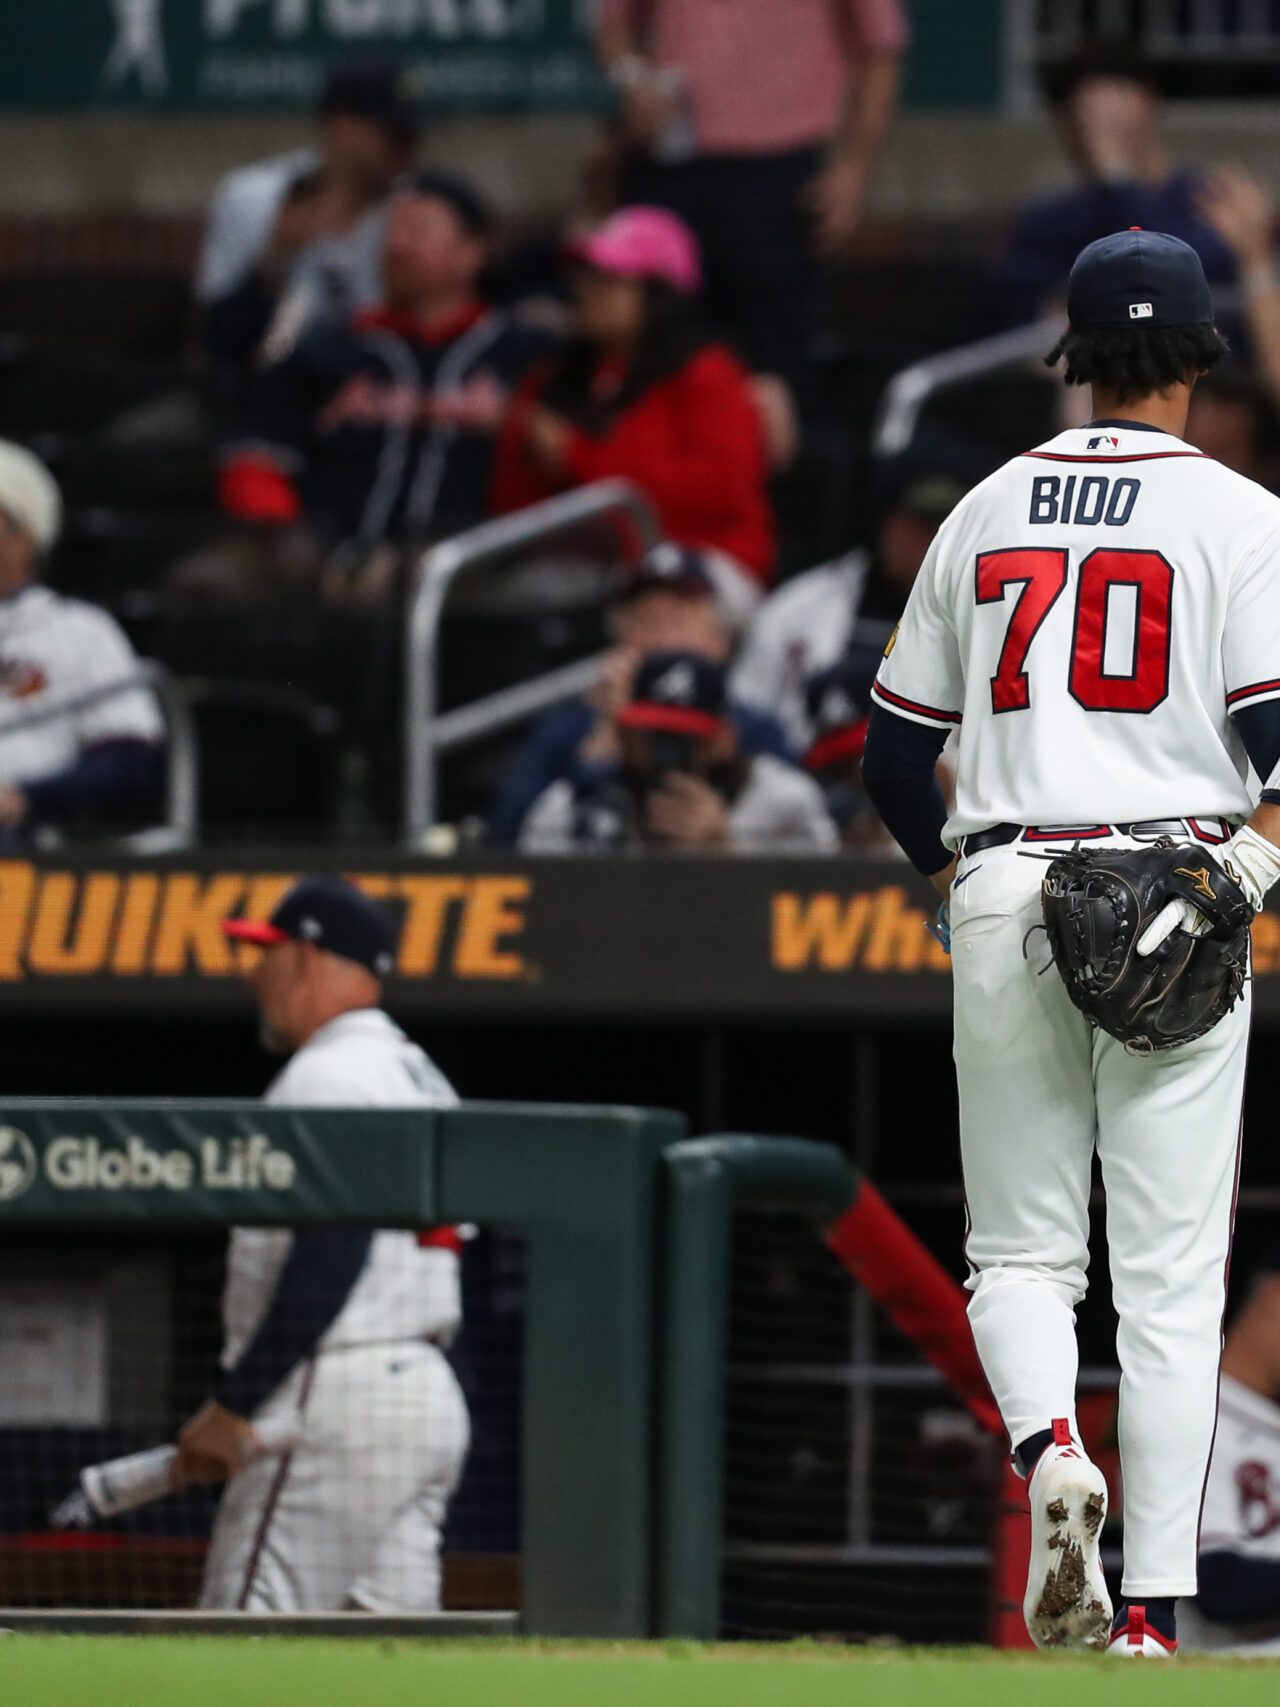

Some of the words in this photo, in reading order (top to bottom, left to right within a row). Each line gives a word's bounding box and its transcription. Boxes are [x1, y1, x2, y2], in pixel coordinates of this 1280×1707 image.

[1029, 475, 1141, 527] BIDO
[975, 546, 1175, 715] 70
[45, 1135, 193, 1190] Globe
[203, 1133, 296, 1190] Life
